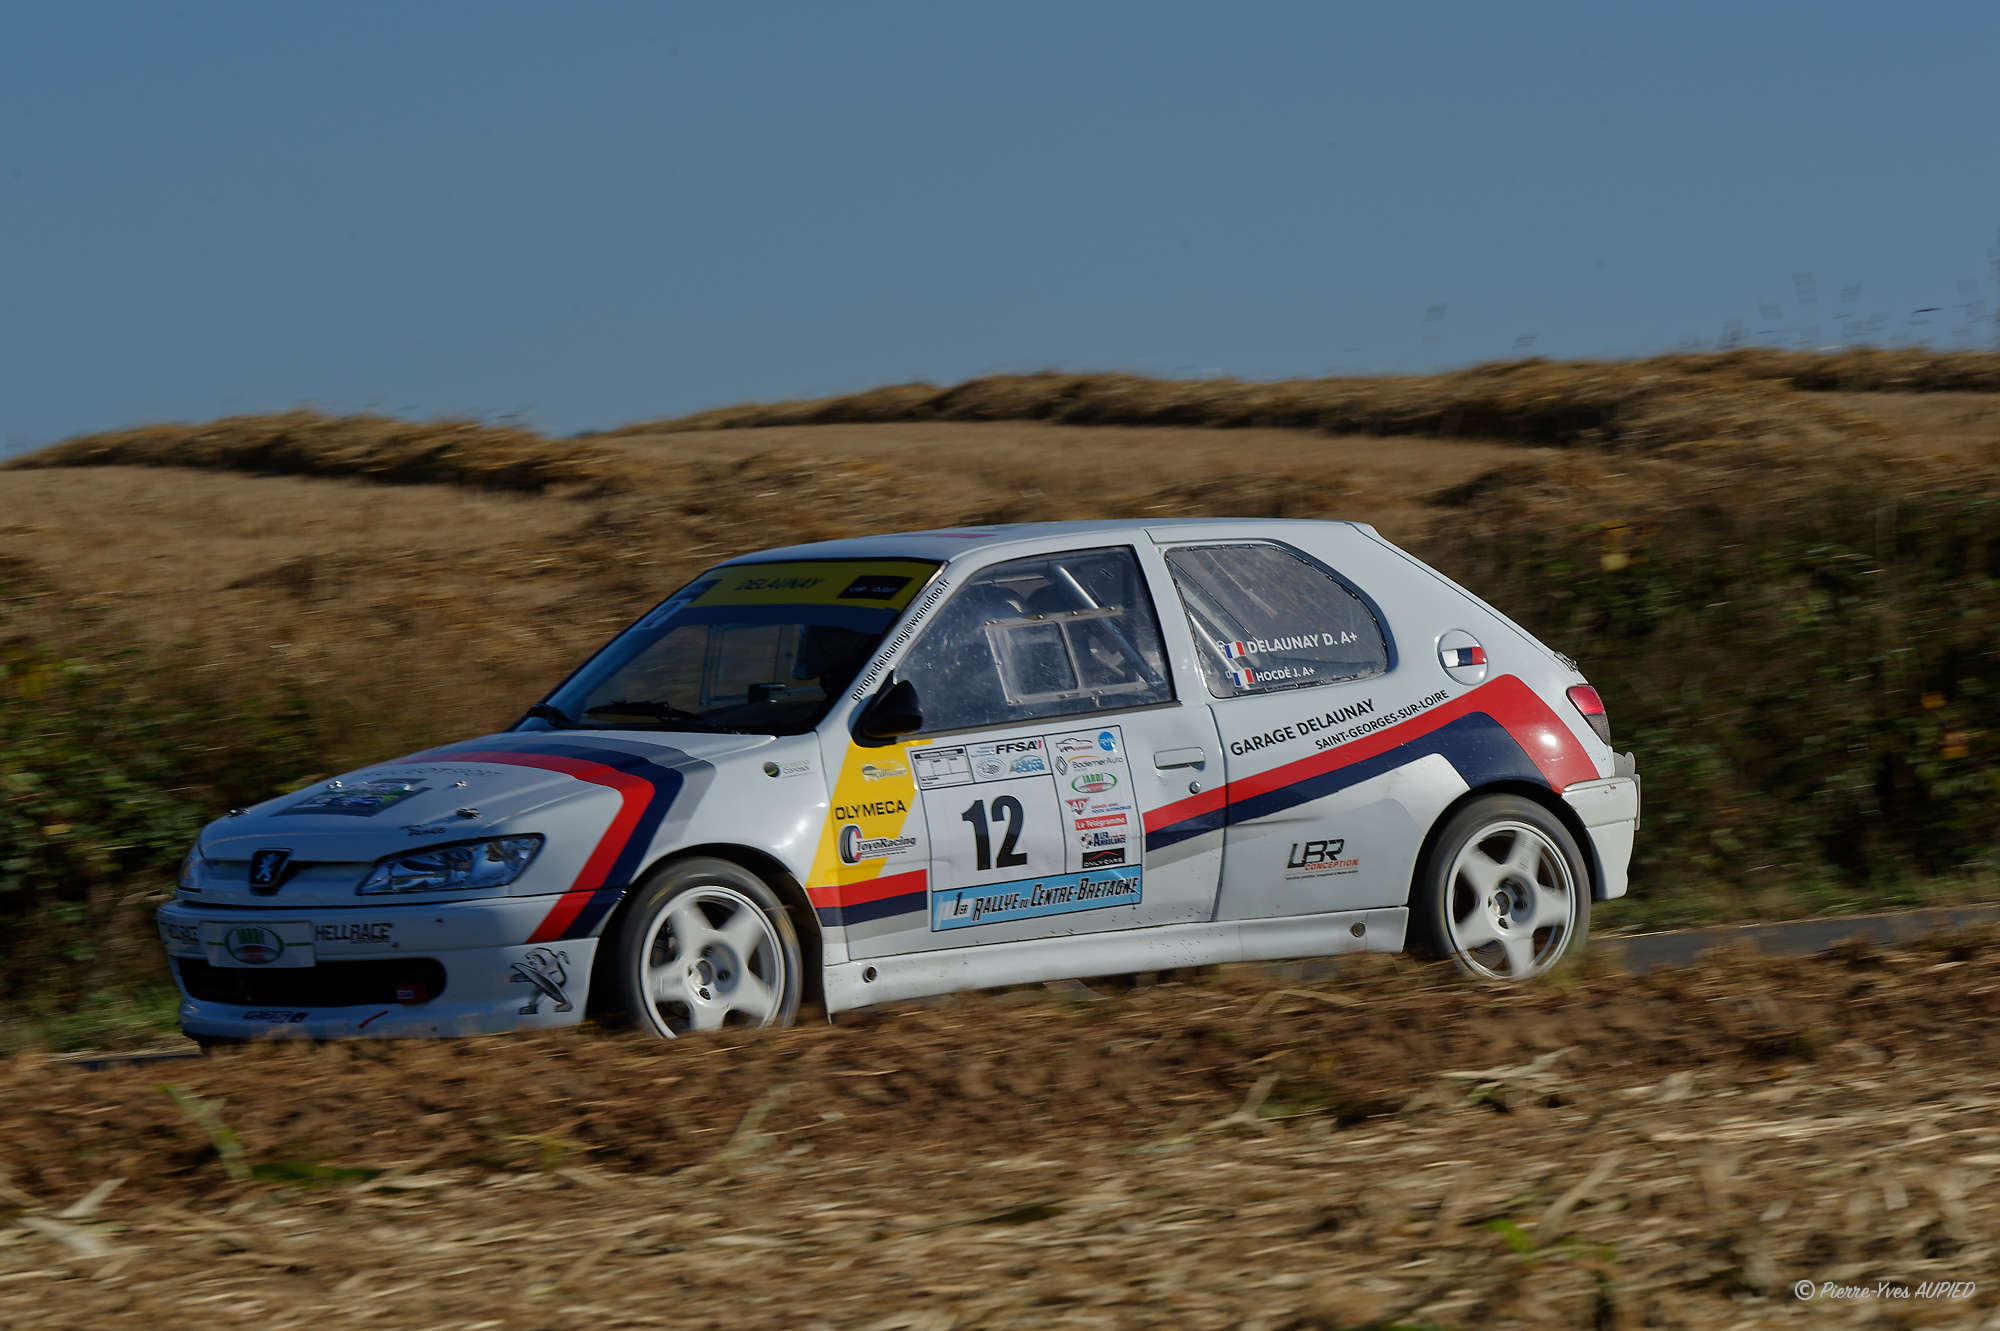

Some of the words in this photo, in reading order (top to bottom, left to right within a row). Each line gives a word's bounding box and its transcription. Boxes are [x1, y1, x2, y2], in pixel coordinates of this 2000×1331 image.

[852, 577, 950, 704] garagedelaunay@wanadoo.fr
[1246, 634, 1320, 654] DELAUNAY
[1322, 633, 1338, 646] D.
[1340, 631, 1359, 645] A+
[1292, 669, 1301, 679] J.
[1230, 726, 1297, 756] GARAGE
[1296, 698, 1376, 736] DELAUNAY
[1315, 689, 1449, 750] SAINT-GEORGES-SUR-LOIRE
[996, 740, 1038, 755] FFSA
[835, 800, 907, 821] OLYMECA
[961, 795, 1028, 871] 12
[1304, 859, 1359, 871] CONCEPTION
[972, 893, 1020, 922] RALLYE
[1031, 877, 1139, 907] CENTRE-BRETAGNE
[314, 922, 396, 942] HELLRACE
